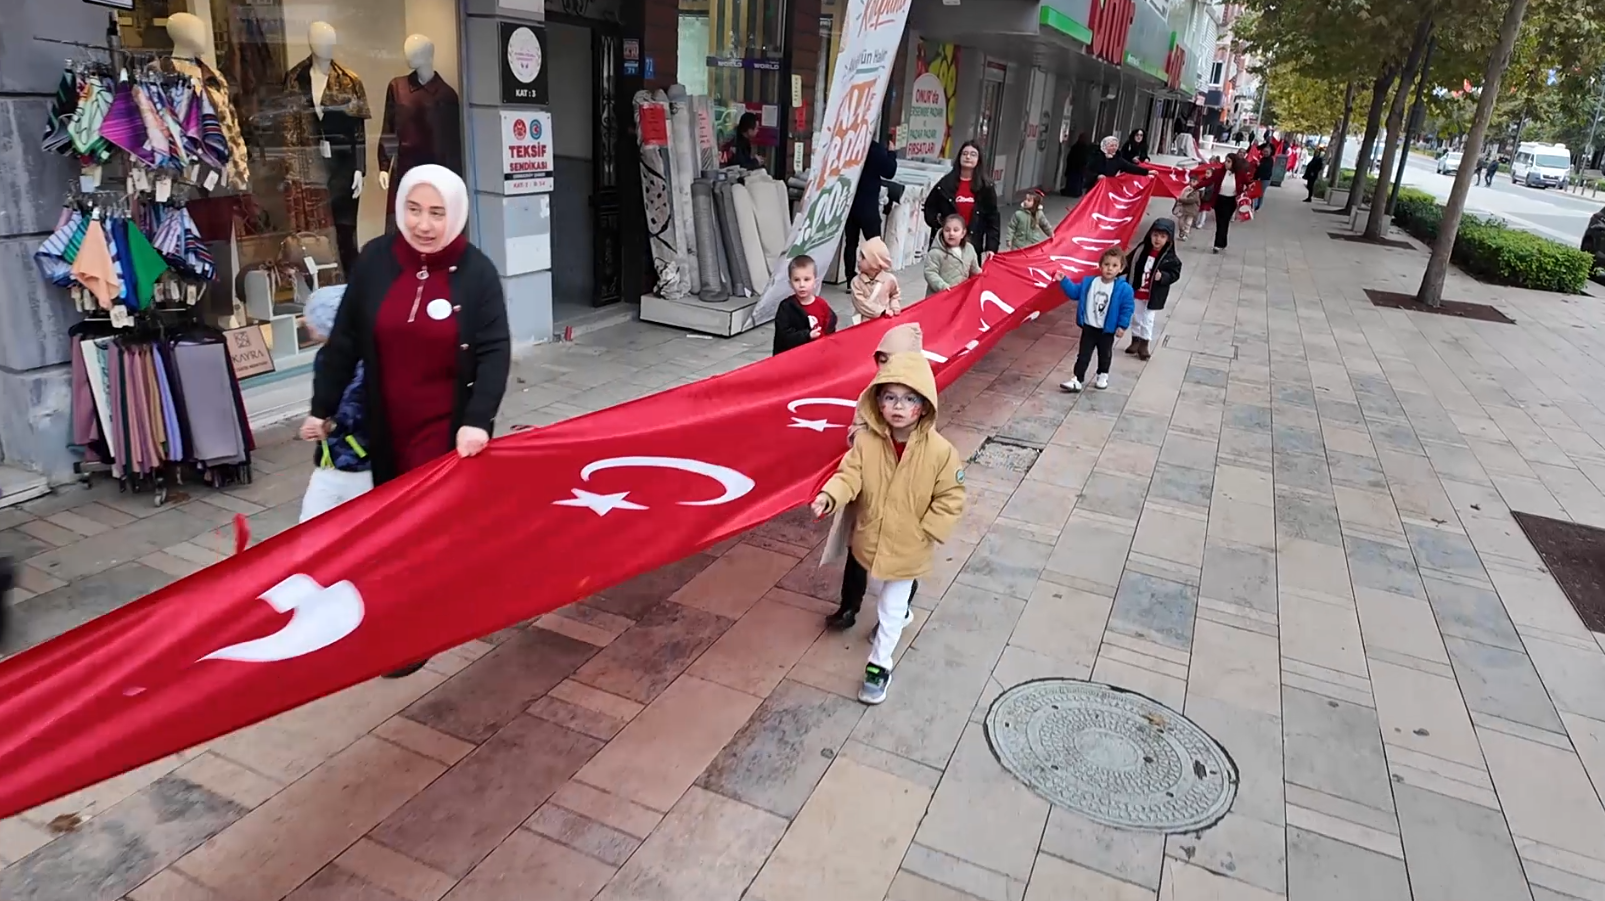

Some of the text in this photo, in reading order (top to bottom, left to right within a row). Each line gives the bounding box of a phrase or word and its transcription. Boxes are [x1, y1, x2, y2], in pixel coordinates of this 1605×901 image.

[508, 141, 547, 158] TEKSİF
[509, 160, 547, 171] SENDİKASI
[231, 349, 264, 363] KAYRA
